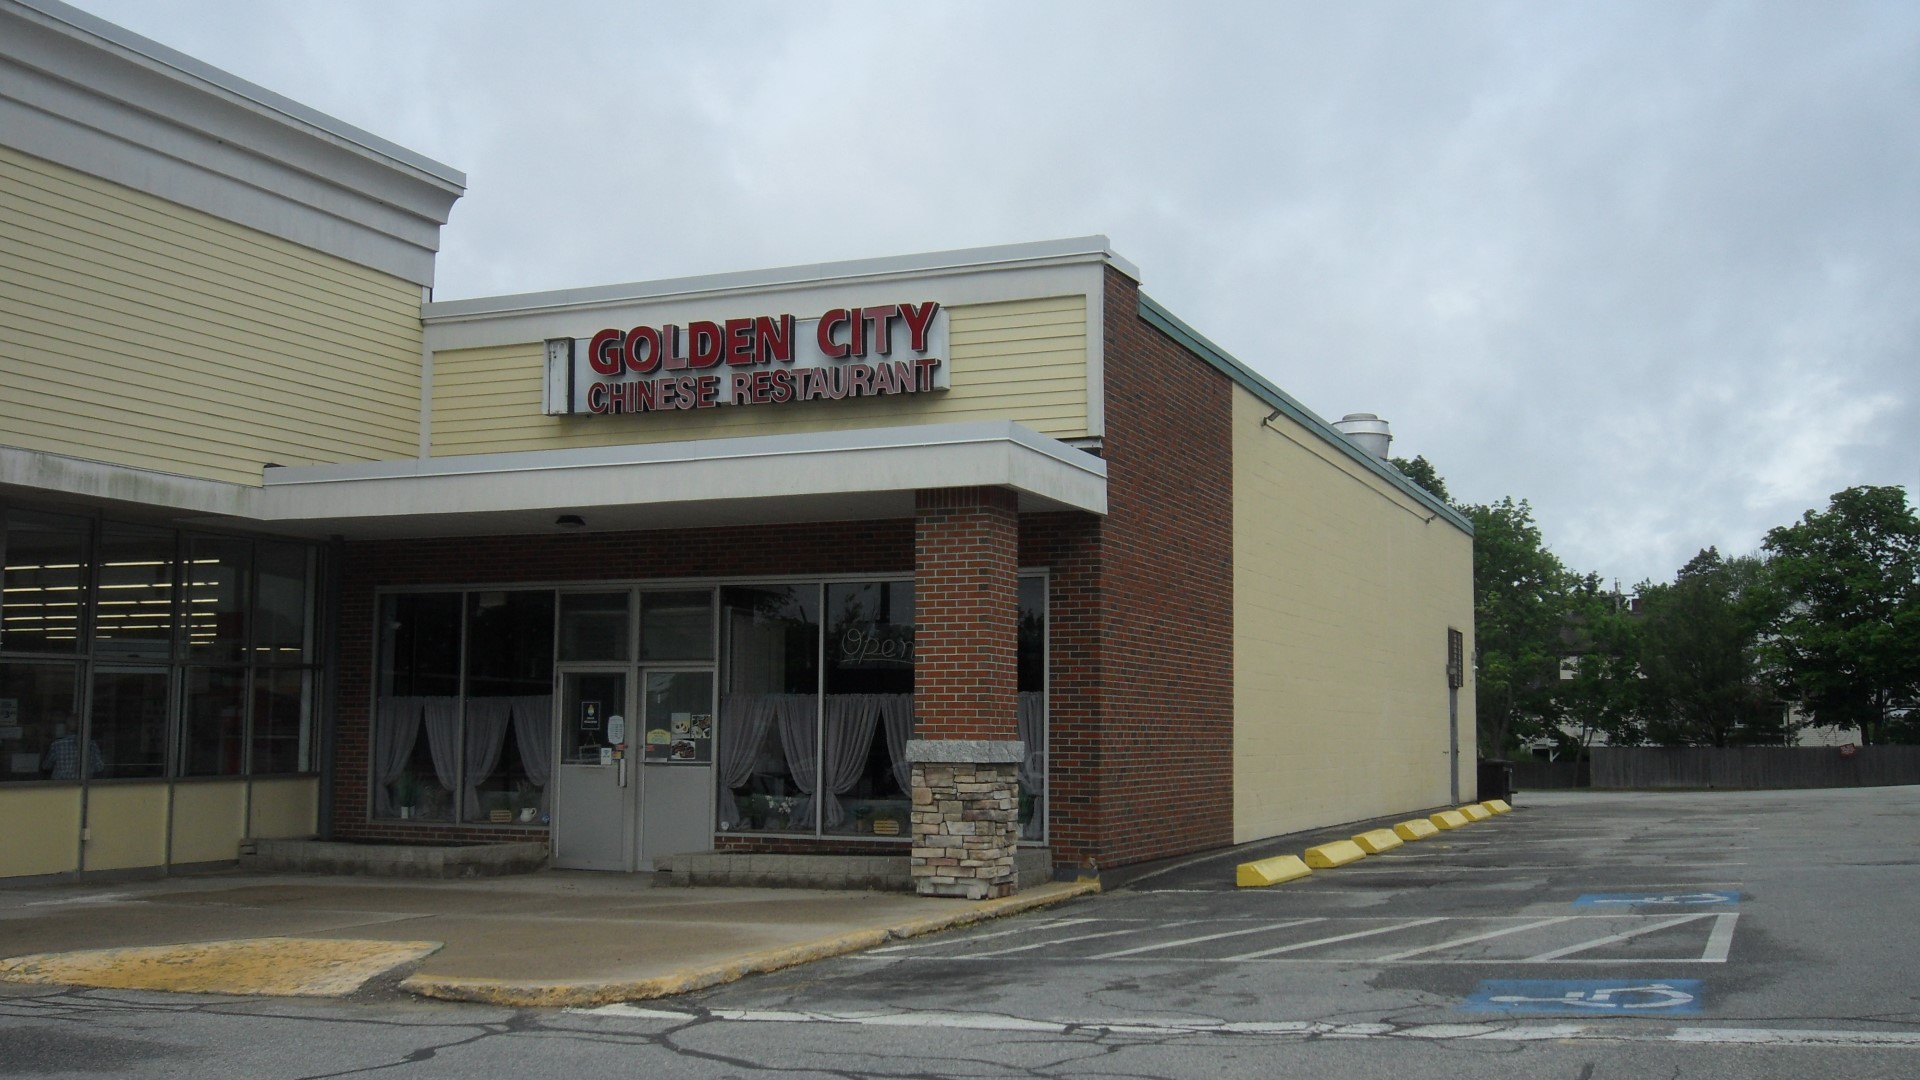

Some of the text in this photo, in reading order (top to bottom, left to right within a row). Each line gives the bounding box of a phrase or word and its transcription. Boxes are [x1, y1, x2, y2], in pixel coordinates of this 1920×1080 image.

[587, 301, 940, 377] GOLDEN CITY
[586, 358, 942, 415] CHINESE RESTAURANT
[841, 627, 915, 664] Open
